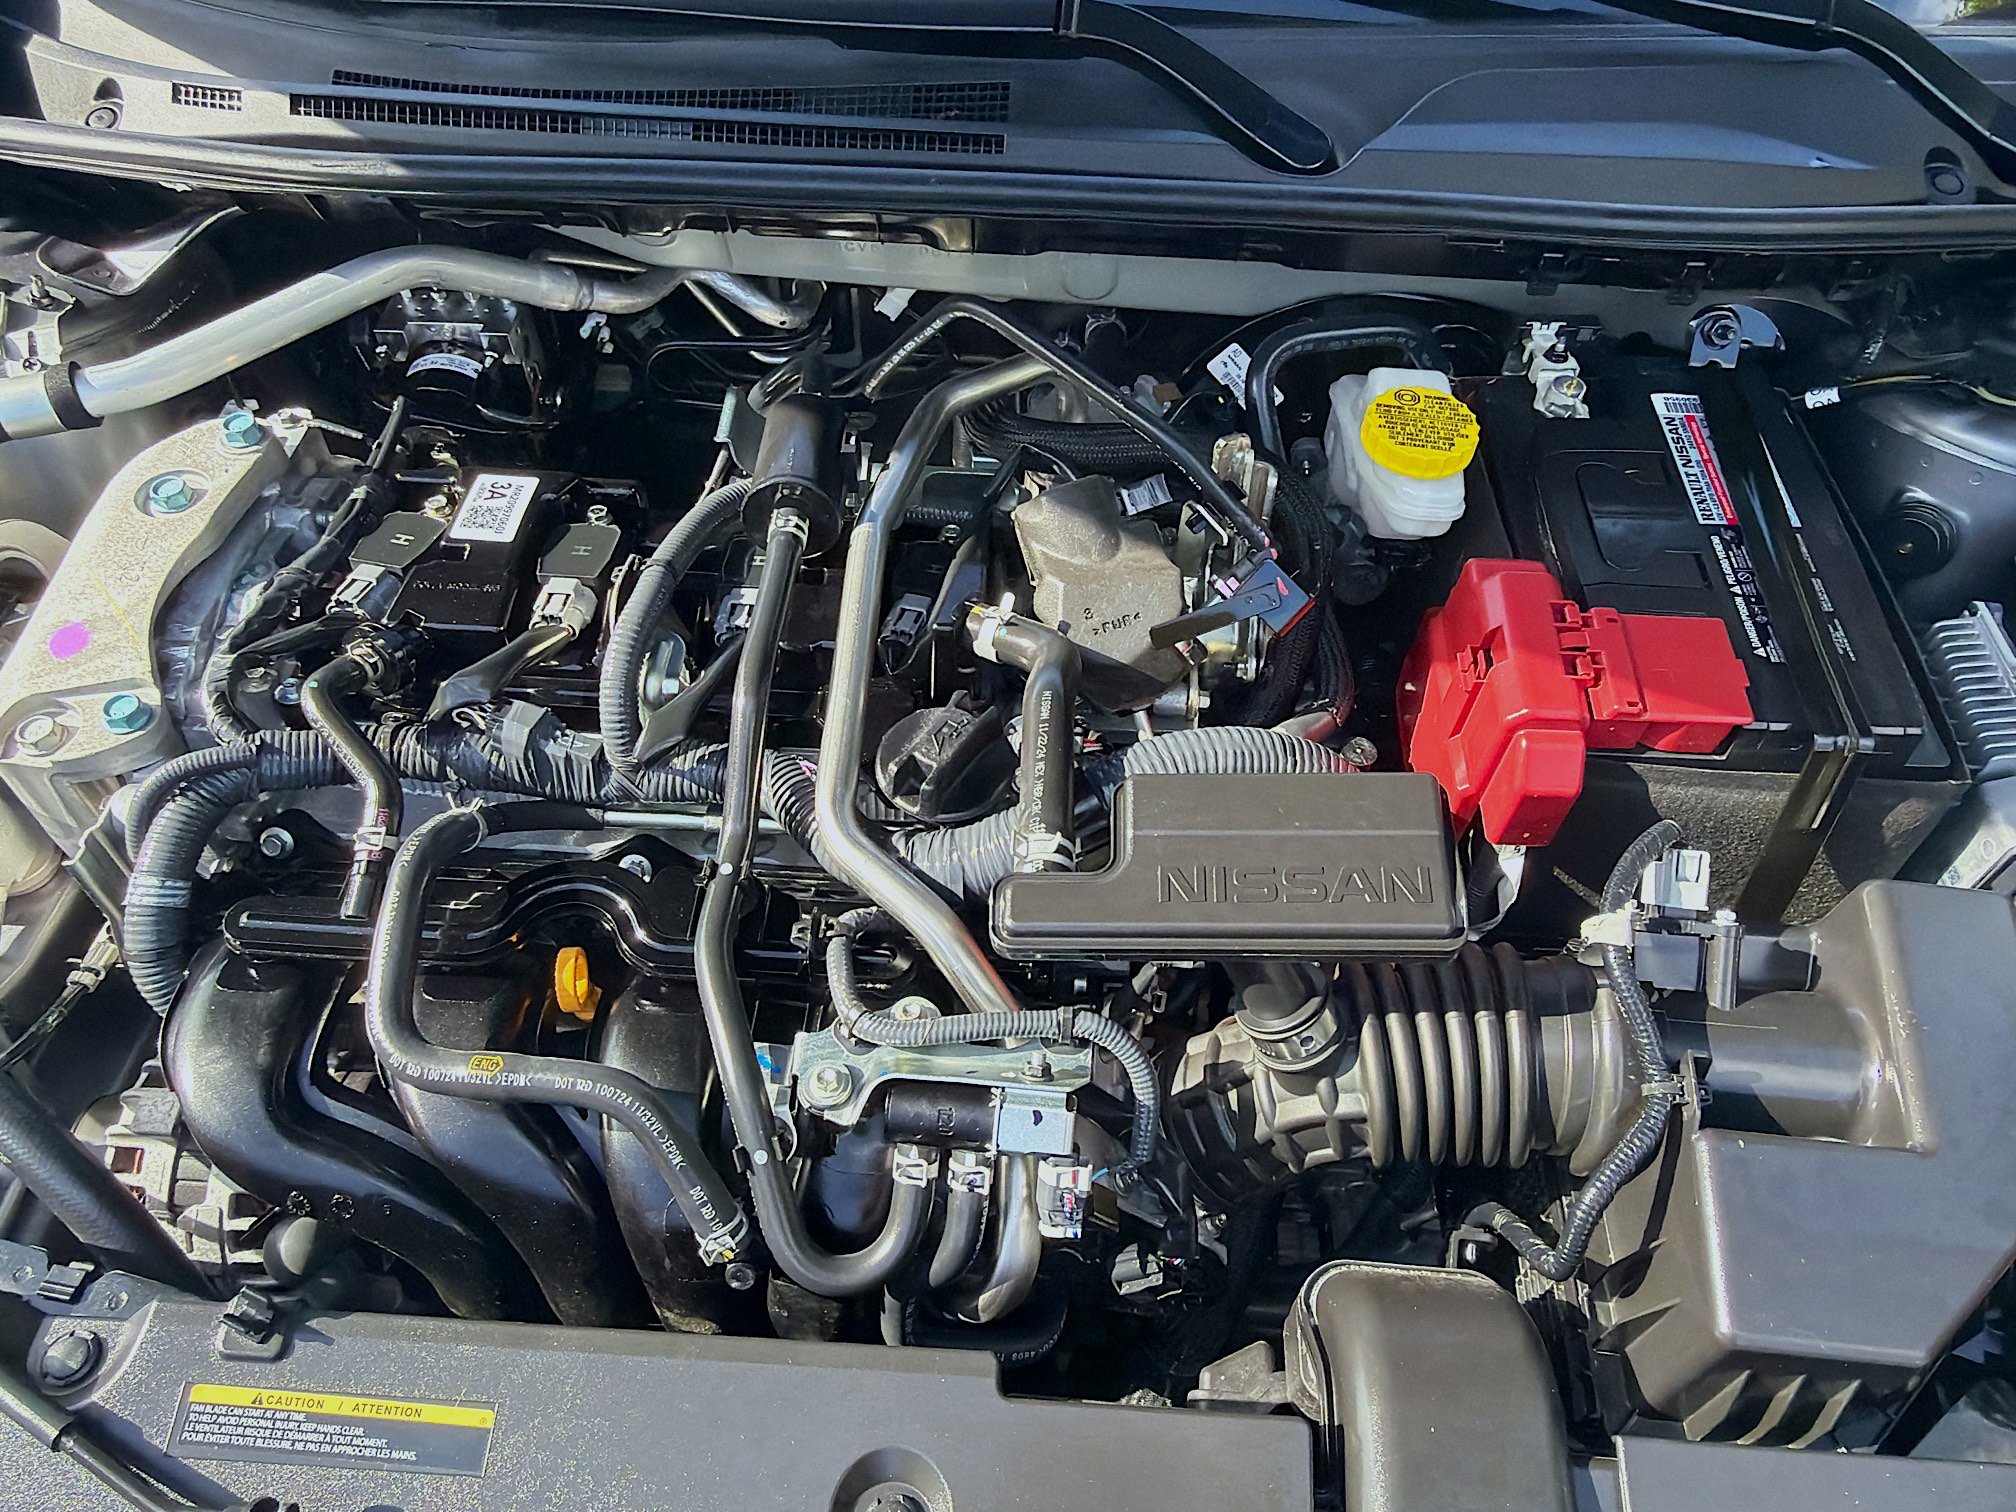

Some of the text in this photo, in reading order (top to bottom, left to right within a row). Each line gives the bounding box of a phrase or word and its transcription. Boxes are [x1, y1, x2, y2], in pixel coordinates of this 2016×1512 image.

[1663, 416, 1695, 469] NISSAN
[483, 481, 513, 501] 3A
[1684, 471, 1716, 521] RENAULT
[1734, 596, 1762, 648] DANGER/POISON
[1040, 690, 1053, 720] NISSAN
[1157, 865, 1434, 904] NISSAN
[388, 1053, 406, 1070] DOT
[423, 1067, 456, 1081] 100724
[471, 1057, 499, 1072] ENG
[554, 1076, 574, 1090] DOT
[595, 1083, 633, 1107] 100724
[630, 1101, 665, 1137] 11/32VL
[658, 1134, 688, 1171] >EPDM<
[689, 1185, 708, 1206] DOT
[190, 1403, 205, 1412] FAN
[205, 1404, 228, 1414] BLADE
[228, 1406, 243, 1415] CAN
[243, 1408, 264, 1417] START
[263, 1409, 273, 1418] AT
[266, 1395, 325, 1410] CAUTION
[352, 1402, 423, 1418] ATTENTION
[184, 1422, 195, 1431] LE
[194, 1422, 244, 1435] VENTILATEUR
[244, 1426, 271, 1438] RISQUE
[271, 1428, 283, 1438] DE
[283, 1428, 324, 1443] DÉMARRER
[331, 1434, 351, 1444] TOUT
[352, 1436, 388, 1448] MOMENT.
[188, 1413, 201, 1422] TO
[200, 1414, 217, 1423] HELP
[216, 1415, 239, 1426] AVOID
[239, 1417, 275, 1428] PERSONAL
[298, 1421, 317, 1431] KEEP
[317, 1423, 341, 1434] HANDS
[341, 1425, 365, 1436] CLEAR.
[181, 1431, 417, 1461] POUR ÉVITER TOUTE BLESSURE, NE PAS EN APPROCHER LES MAINS.
